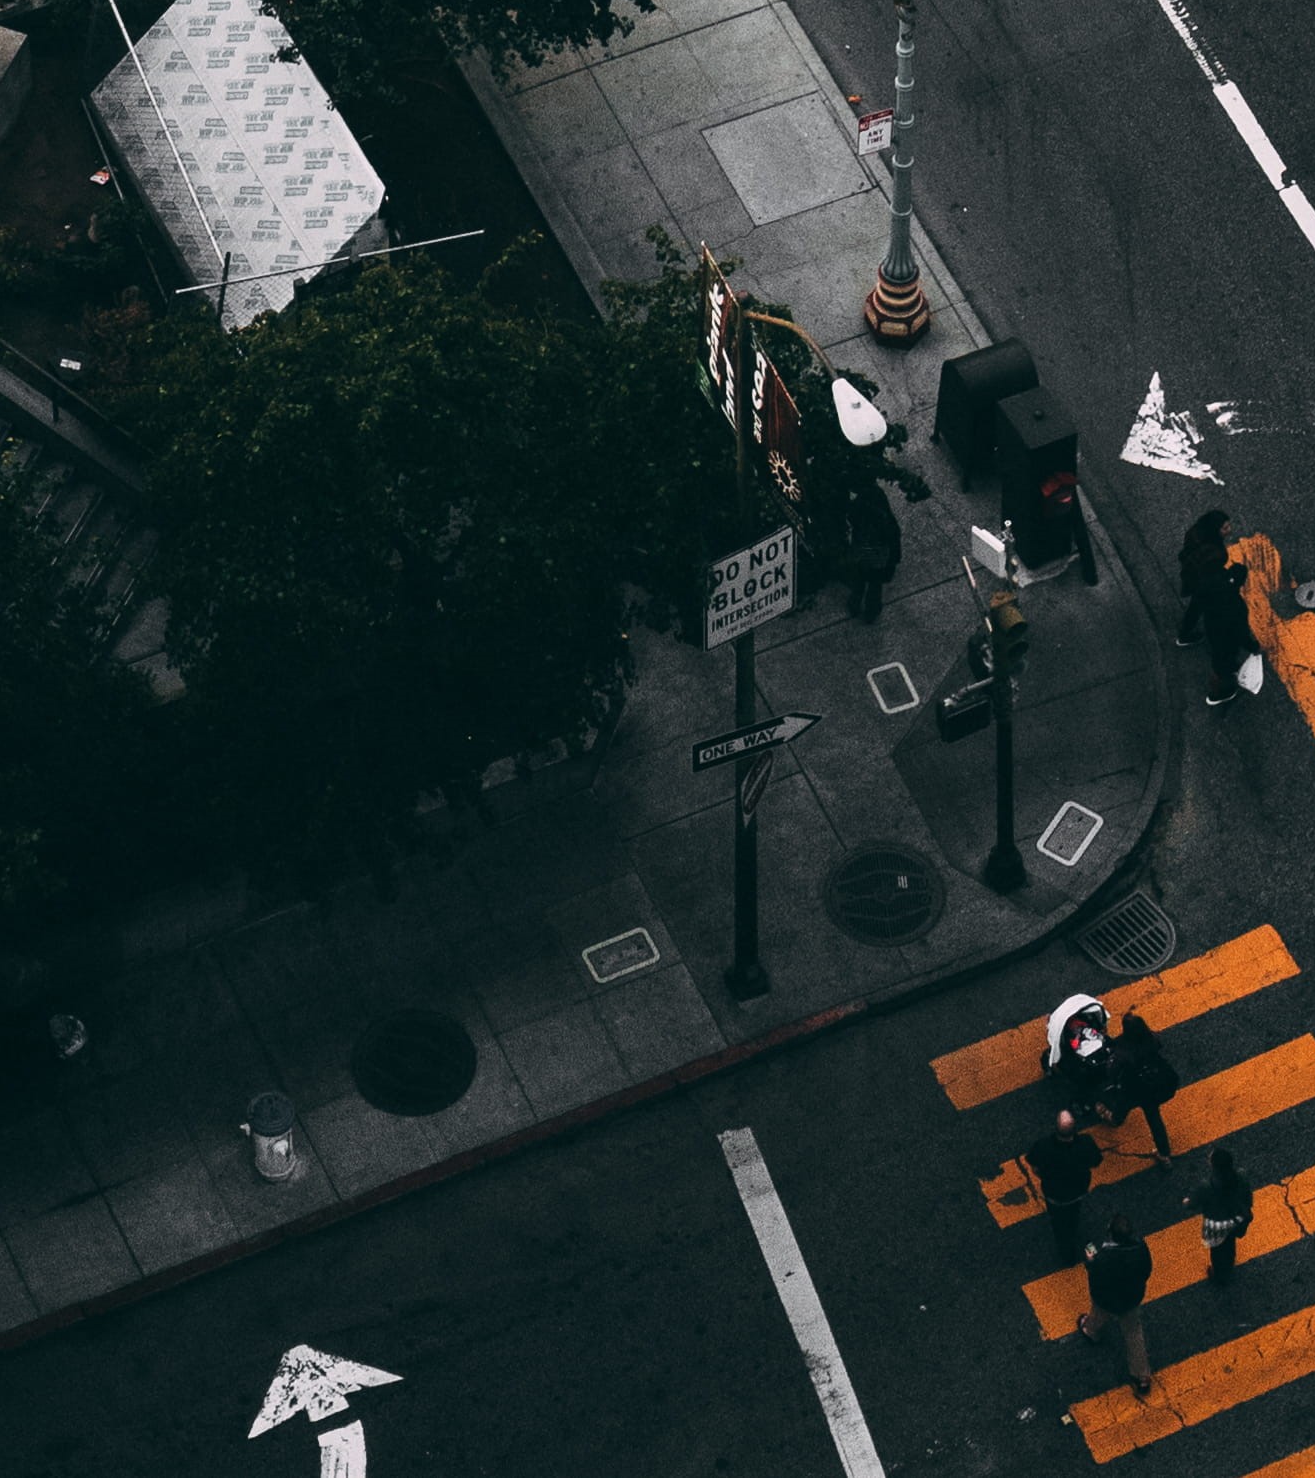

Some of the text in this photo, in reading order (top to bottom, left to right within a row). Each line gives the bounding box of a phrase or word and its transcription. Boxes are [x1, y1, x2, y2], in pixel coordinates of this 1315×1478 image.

[712, 535, 791, 591] DO NOT
[711, 585, 789, 633] INTERSECTION
[713, 563, 787, 613] BLOCK
[703, 727, 777, 763] ONE WAY
